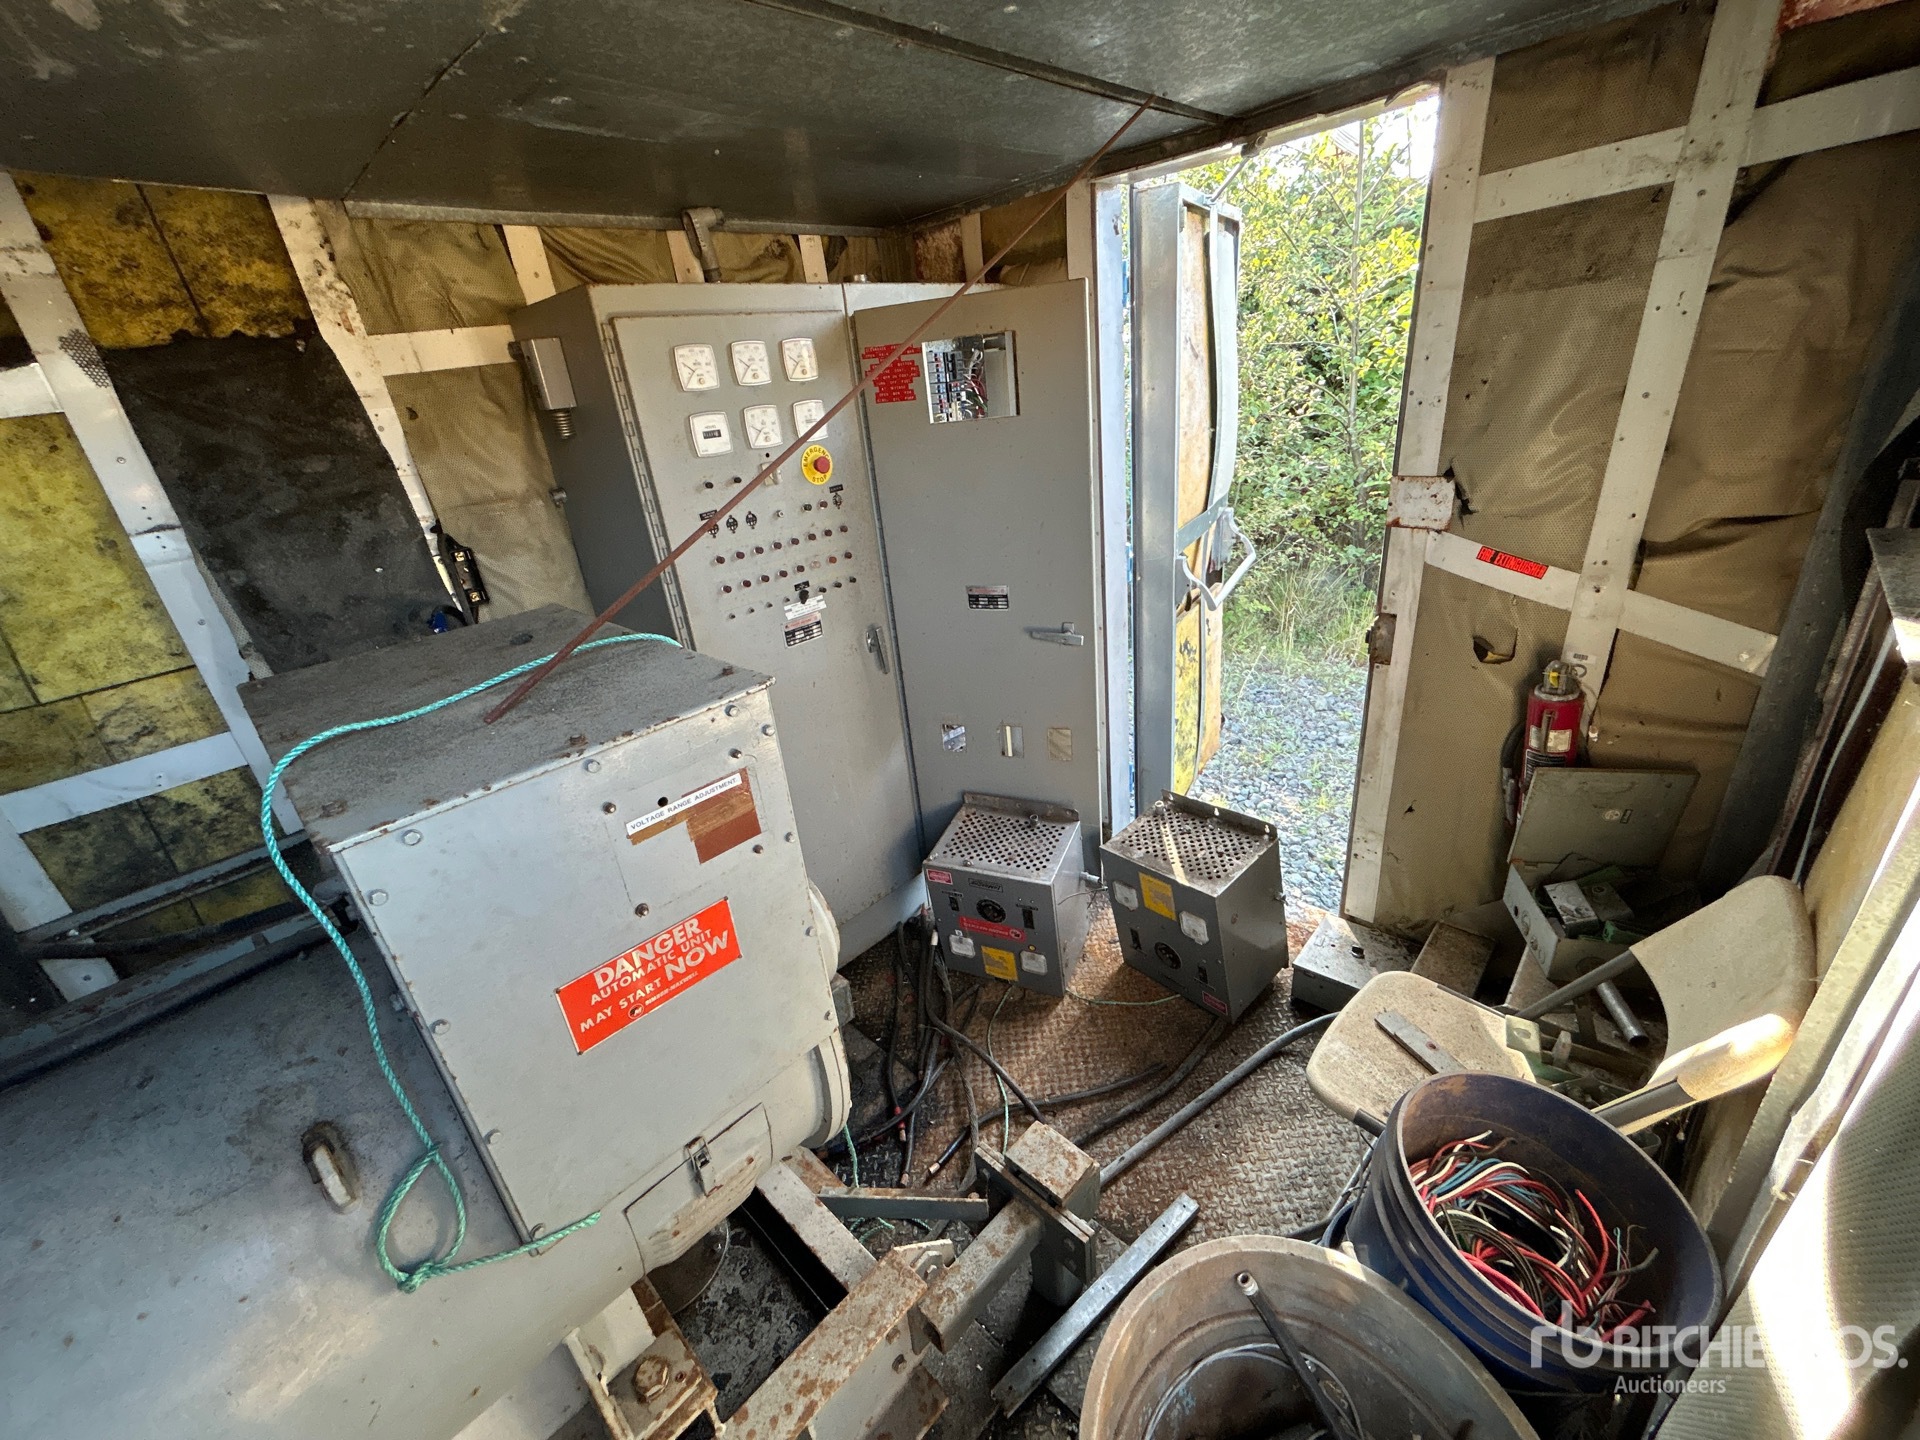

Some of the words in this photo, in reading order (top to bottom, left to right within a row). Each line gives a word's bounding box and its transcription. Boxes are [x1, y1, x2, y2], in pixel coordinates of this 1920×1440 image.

[803, 446, 831, 467] EMERGENC
[812, 474, 827, 483] STOP
[1478, 546, 1495, 563] FIRE
[1493, 552, 1548, 578] EXTINGUISHER
[630, 811, 665, 830] VOLTAGE
[667, 798, 692, 813] RANGE
[694, 777, 738, 801] ADJUSTMENT
[590, 950, 677, 1006] AUTOMATIC
[679, 929, 712, 953] UNIT
[593, 918, 702, 990] DANGER
[580, 1006, 613, 1033] MAY
[618, 978, 662, 1010] START
[664, 930, 729, 982] NOW
